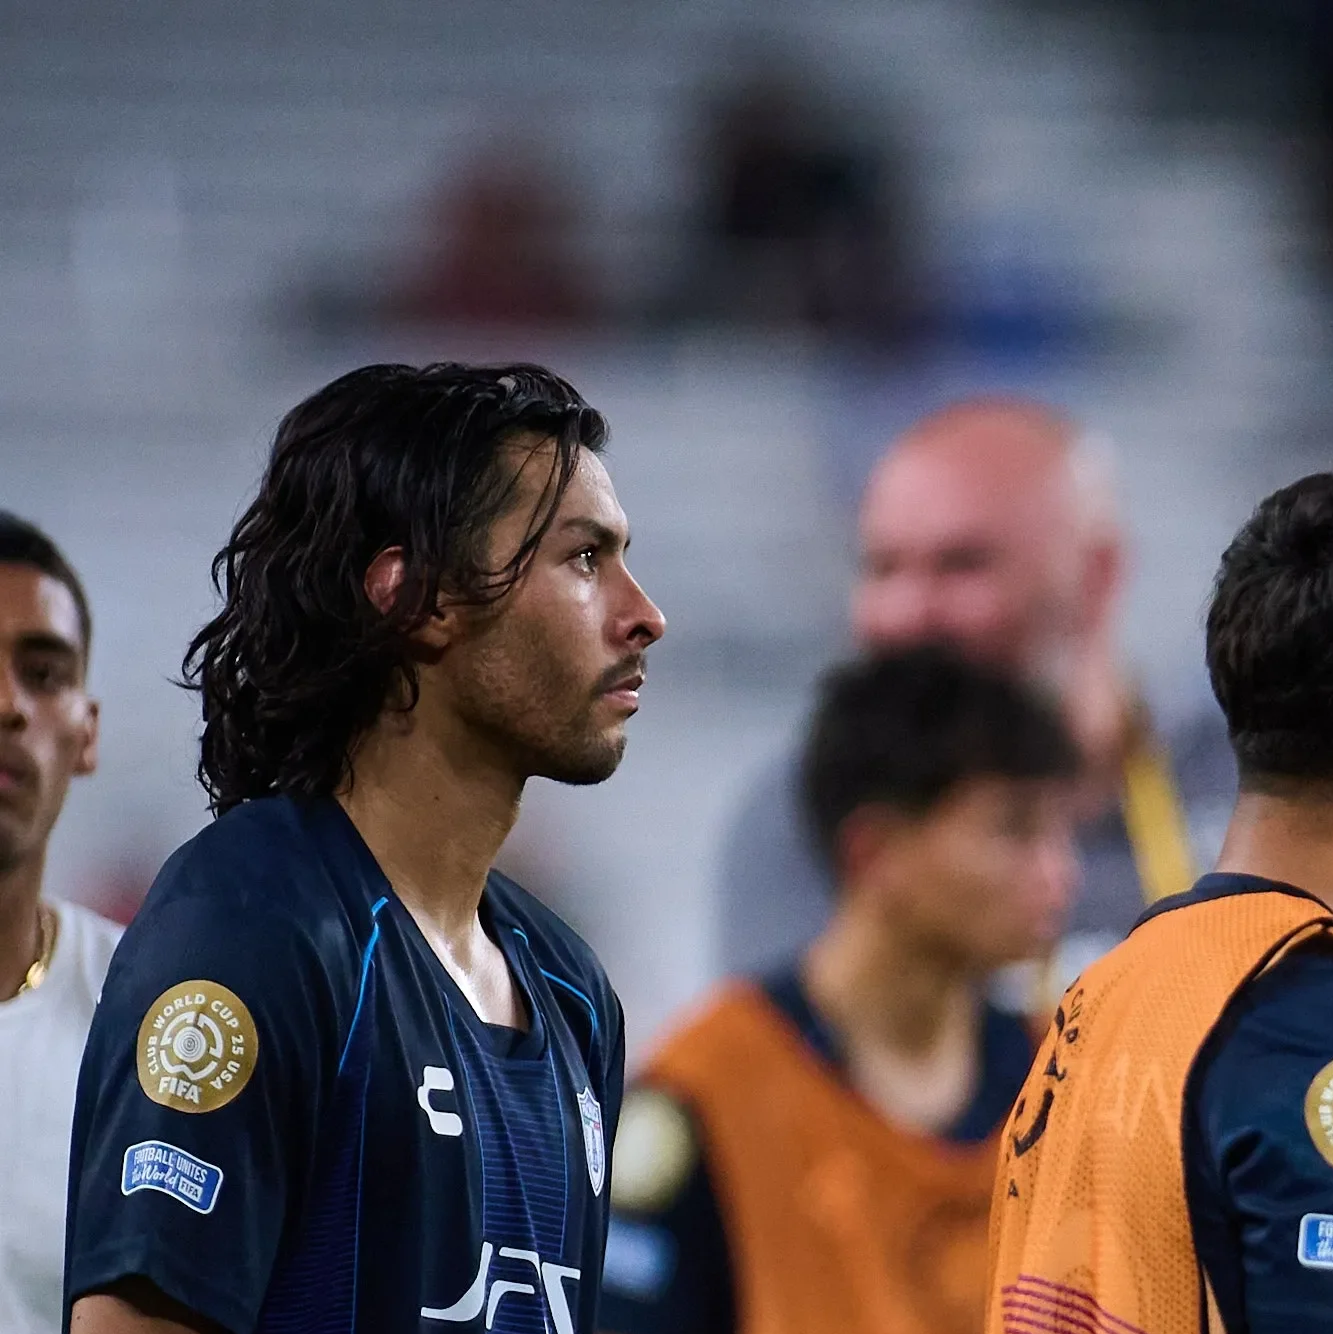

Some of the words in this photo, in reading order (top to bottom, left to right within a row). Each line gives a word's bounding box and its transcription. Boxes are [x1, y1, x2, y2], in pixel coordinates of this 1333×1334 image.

[153, 993, 206, 1030] WORLD
[210, 1000, 239, 1029] CUP
[147, 1035, 159, 1075] CLUB
[231, 1034, 244, 1056] 25
[210, 1060, 241, 1090] USA
[158, 1076, 200, 1104] FIFA
[142, 1163, 180, 1189] World
[176, 1155, 208, 1183] UNITES
[180, 1180, 200, 1199] FIFA
